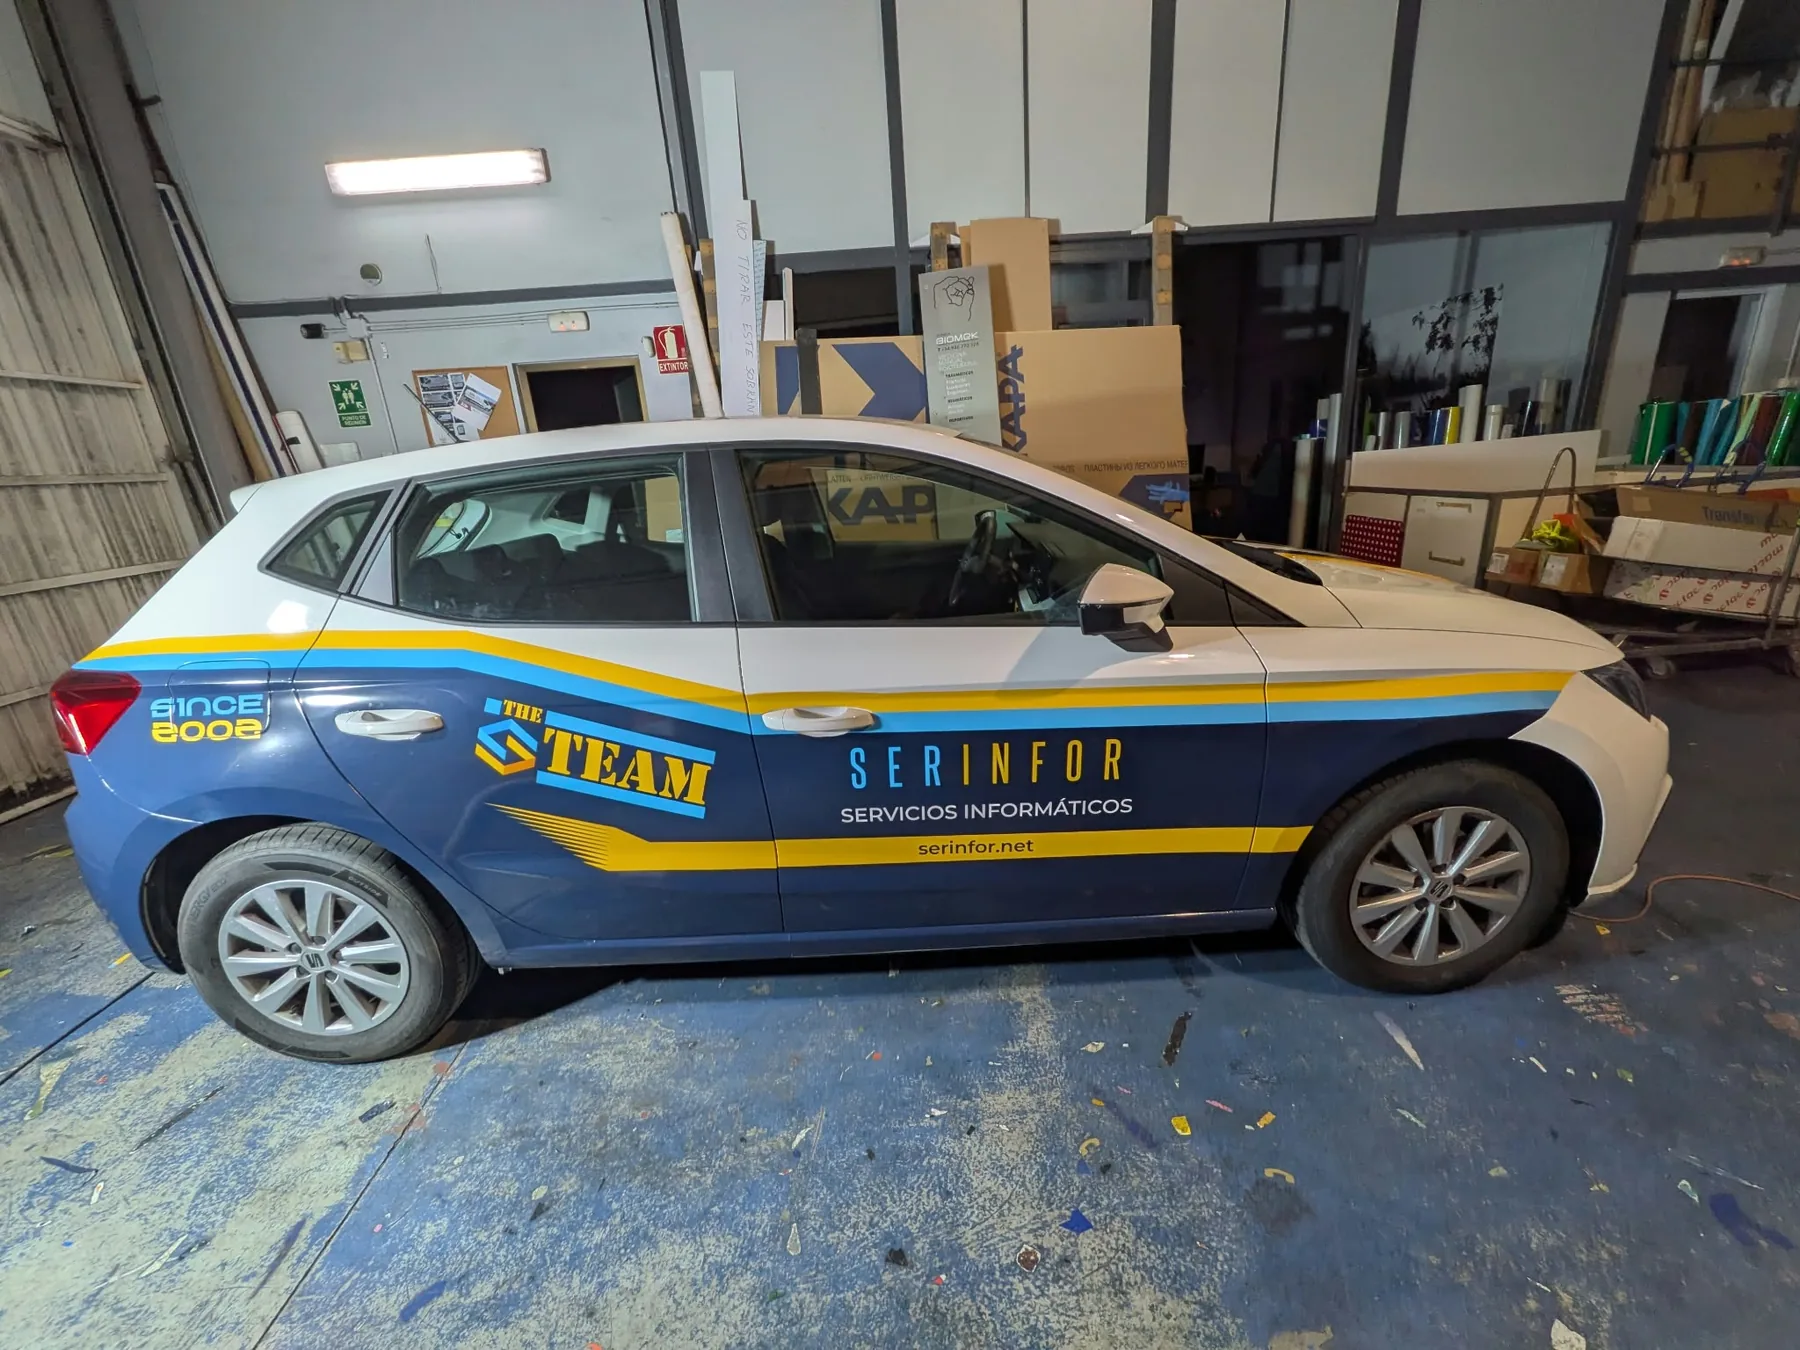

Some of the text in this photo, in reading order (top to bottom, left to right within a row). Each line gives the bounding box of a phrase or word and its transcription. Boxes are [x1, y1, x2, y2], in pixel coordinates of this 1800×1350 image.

[736, 219, 748, 241] NO
[737, 254, 751, 305] TIRAR
[742, 322, 754, 358] ESTE
[659, 361, 689, 371] EXTINTOR
[998, 345, 1028, 452] KAPA
[150, 694, 264, 718] SINCE
[503, 699, 543, 723] THE
[543, 727, 711, 805] TEAM
[849, 738, 1122, 789] SERINFOR
[841, 797, 1133, 823] SERVICIOS INFORMÁTICOS
[918, 839, 1034, 855] serinfor.net
